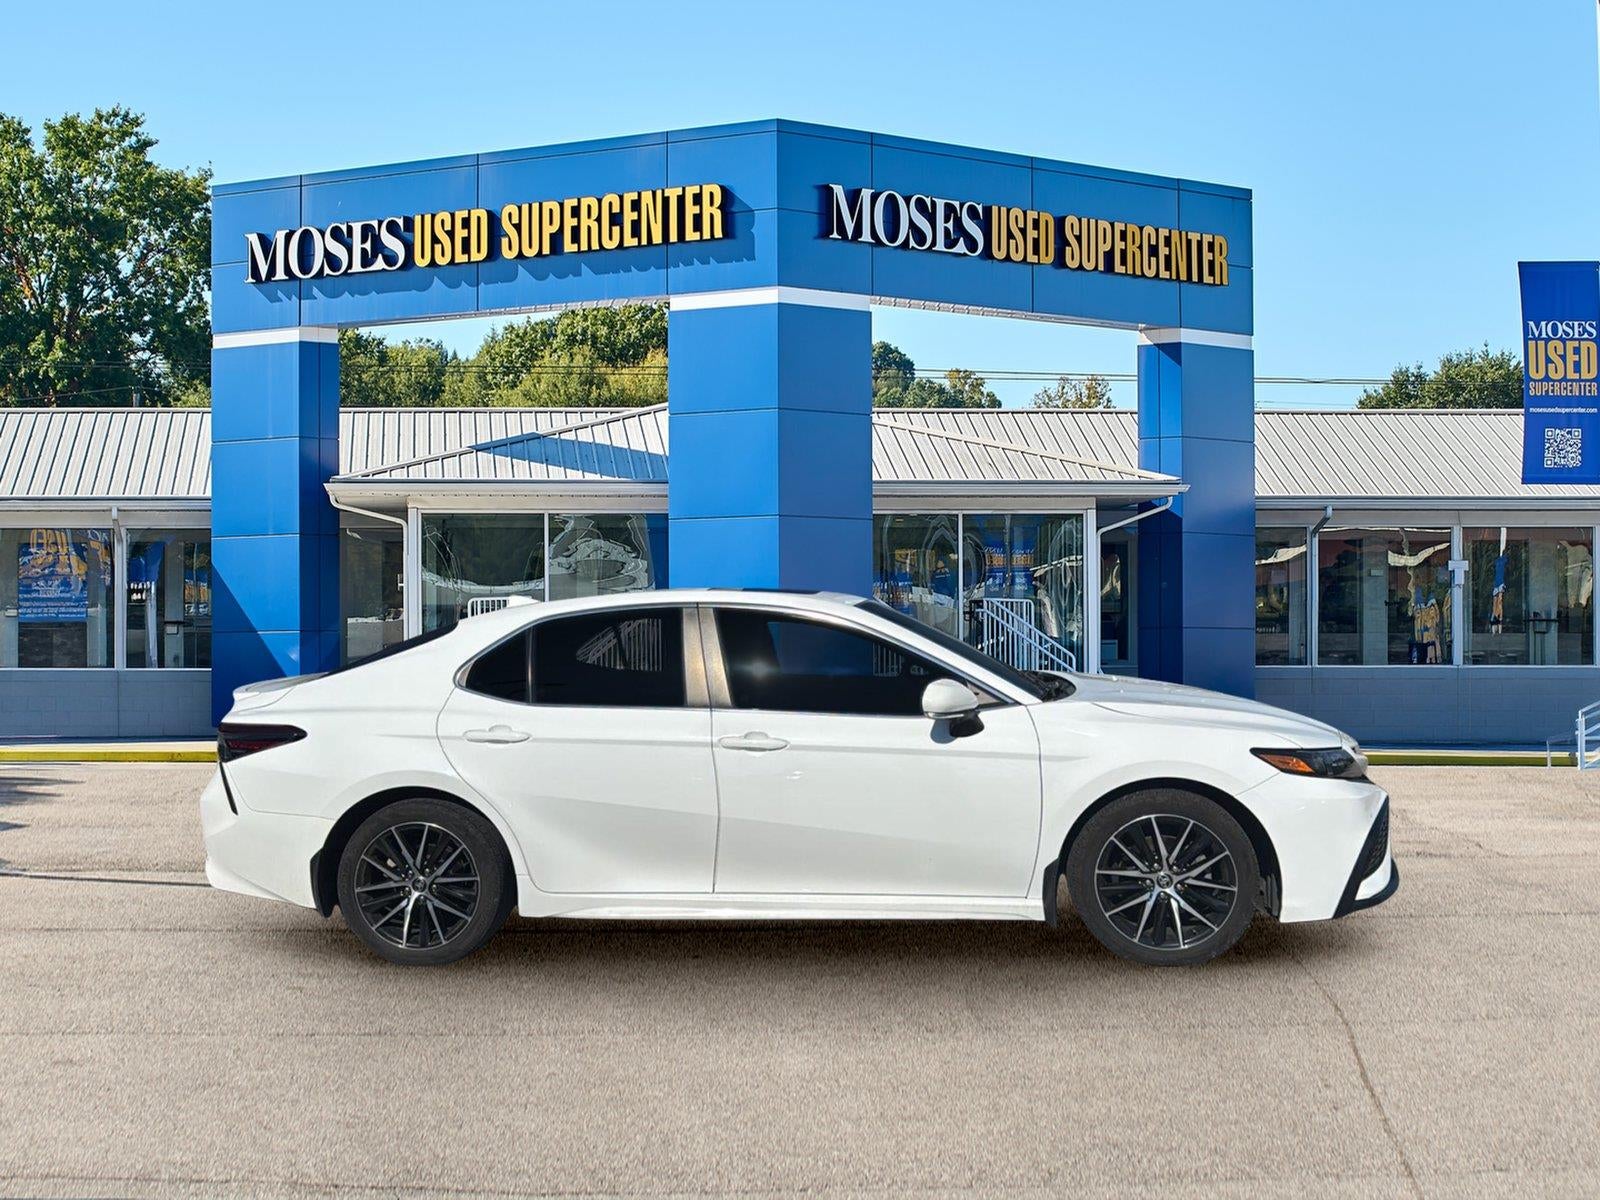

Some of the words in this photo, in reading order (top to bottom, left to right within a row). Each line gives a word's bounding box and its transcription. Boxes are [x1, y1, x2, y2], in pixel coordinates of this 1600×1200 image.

[244, 216, 408, 283] MOSES
[413, 208, 489, 267] USED
[501, 183, 723, 259] SUPERCENTER
[829, 184, 984, 256] MOSES
[992, 205, 1054, 264] USED
[1065, 215, 1229, 286] SUPERCENTER
[1527, 320, 1597, 339] MOSES
[1528, 340, 1598, 380] USED
[1529, 381, 1598, 396] SUPERCENTER
[1529, 406, 1598, 414] mosesusedsupercenter.com
